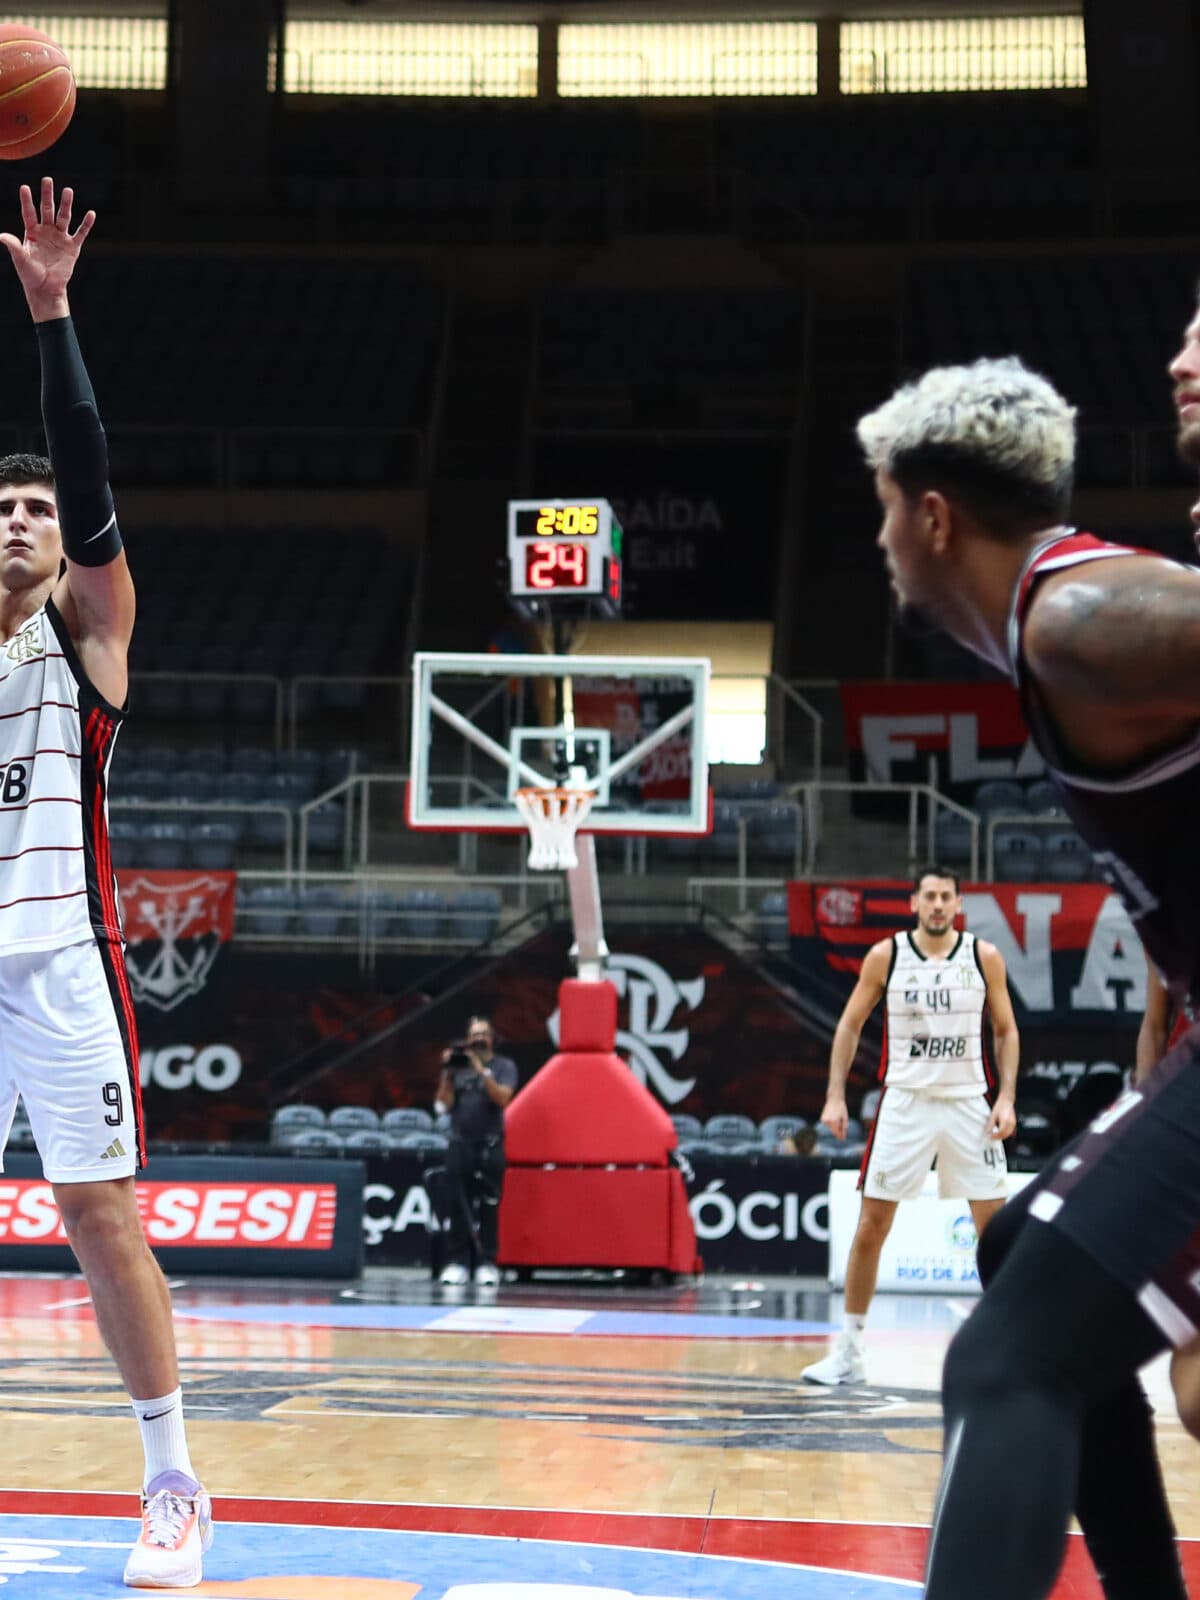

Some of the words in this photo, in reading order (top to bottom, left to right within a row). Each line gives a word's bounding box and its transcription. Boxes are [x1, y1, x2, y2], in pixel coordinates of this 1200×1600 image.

[537, 507, 598, 535] 2:06
[529, 542, 585, 588] 24
[926, 988, 950, 1013] 44
[929, 1037, 966, 1057] BRB
[102, 1082, 123, 1127] 9
[147, 1188, 318, 1241] SESI
